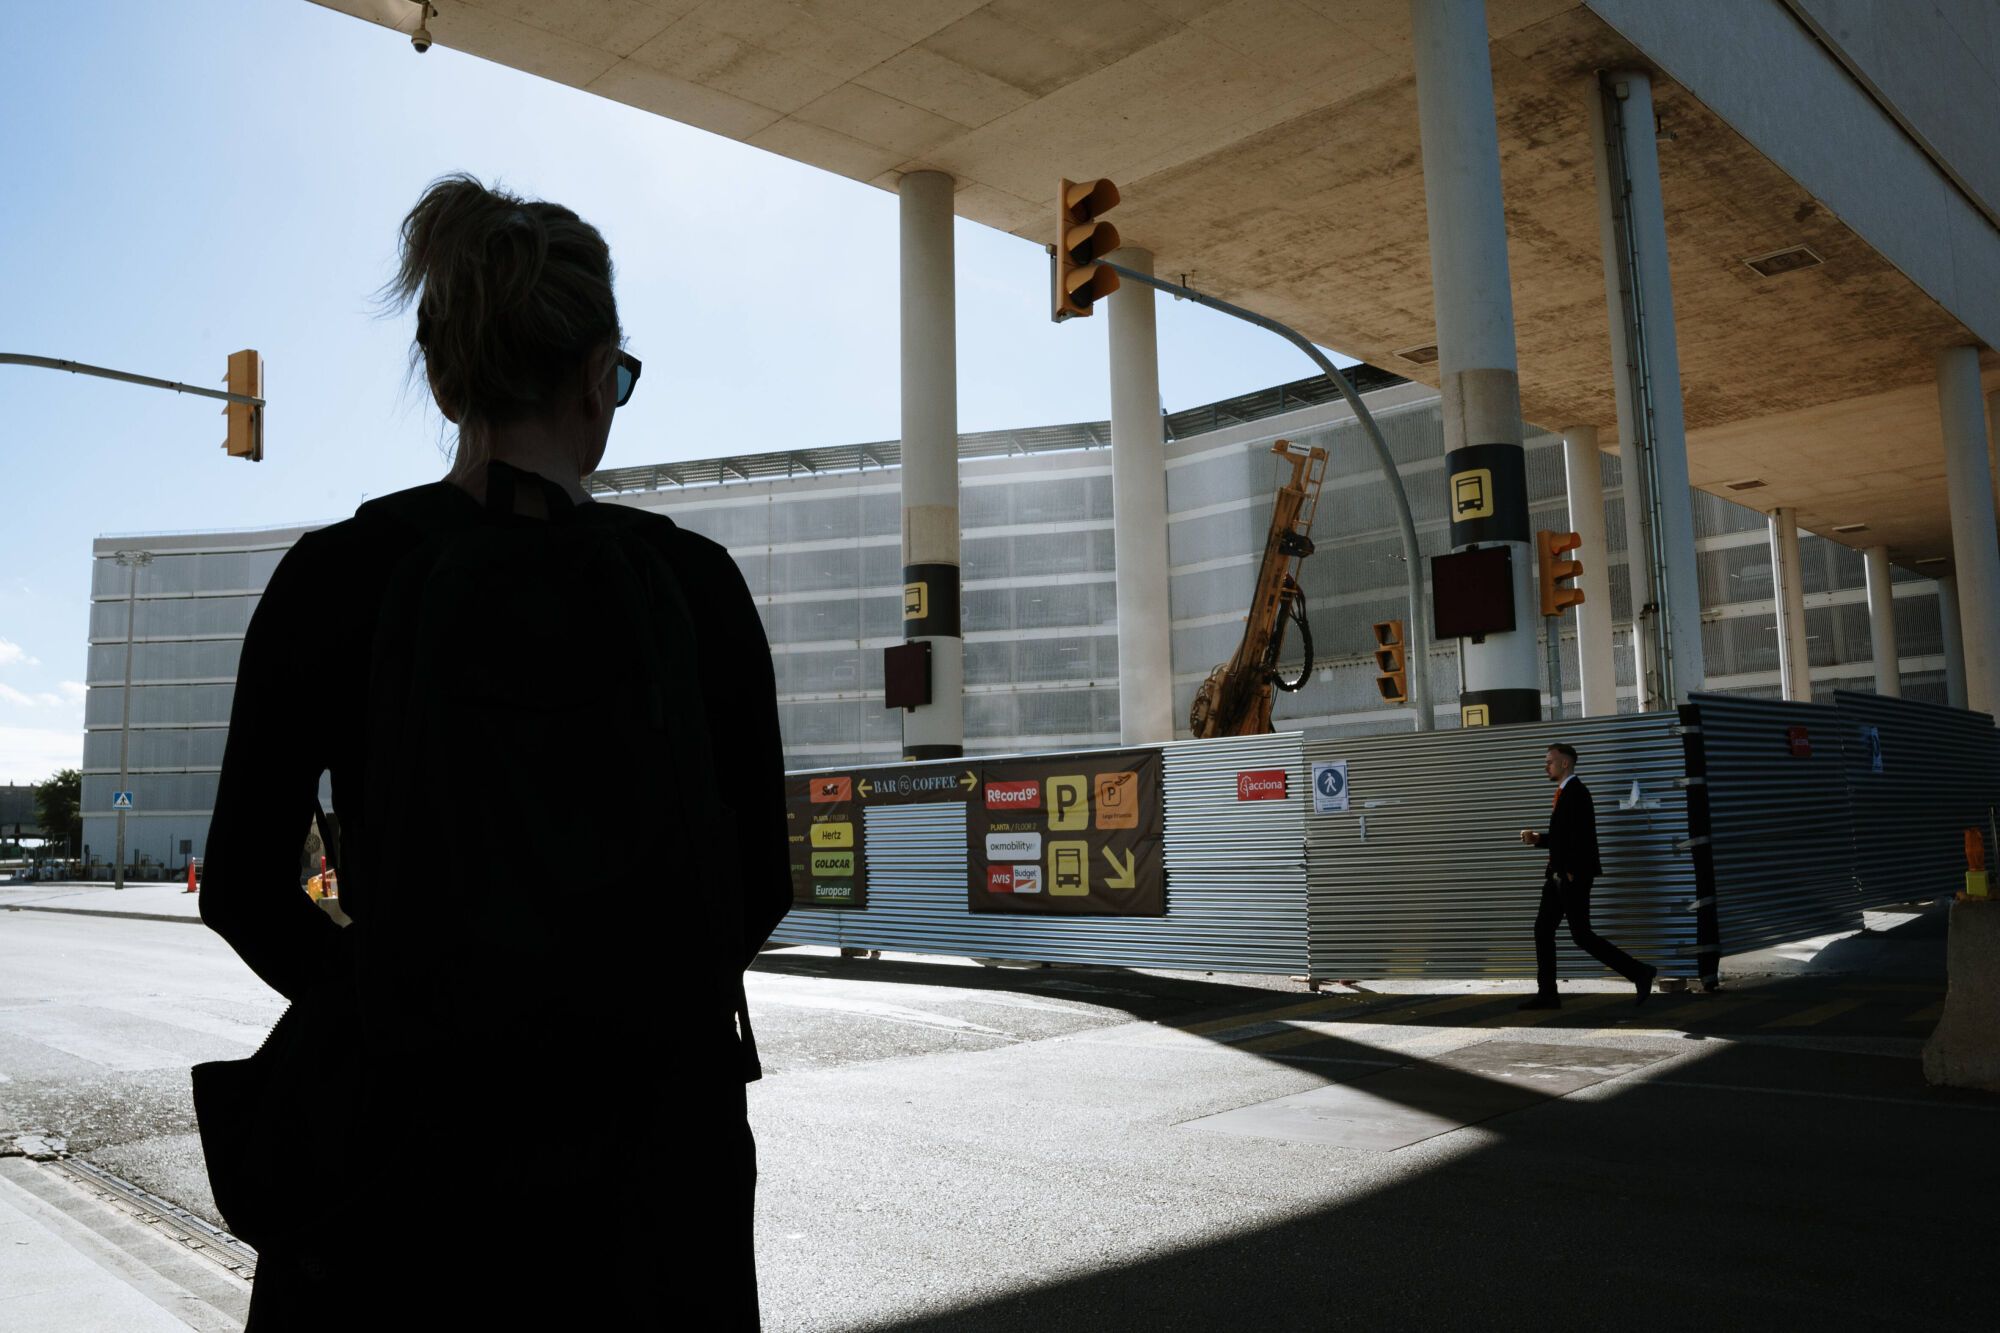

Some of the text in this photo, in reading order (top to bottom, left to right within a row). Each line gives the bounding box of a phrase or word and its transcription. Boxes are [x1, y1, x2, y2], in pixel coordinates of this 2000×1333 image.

[873, 779, 897, 793] BAR
[912, 775, 958, 791] COFFEE
[1248, 779, 1283, 791] acciona
[1056, 784, 1078, 822] P
[990, 823, 1009, 831] PLANTA
[1014, 822, 1032, 831] FLOOR
[822, 830, 842, 840] Hertz
[815, 859, 850, 869] GOLDCAR
[992, 874, 1010, 884] AVIS
[1015, 869, 1037, 879] Budget
[815, 885, 851, 898] Europcar
